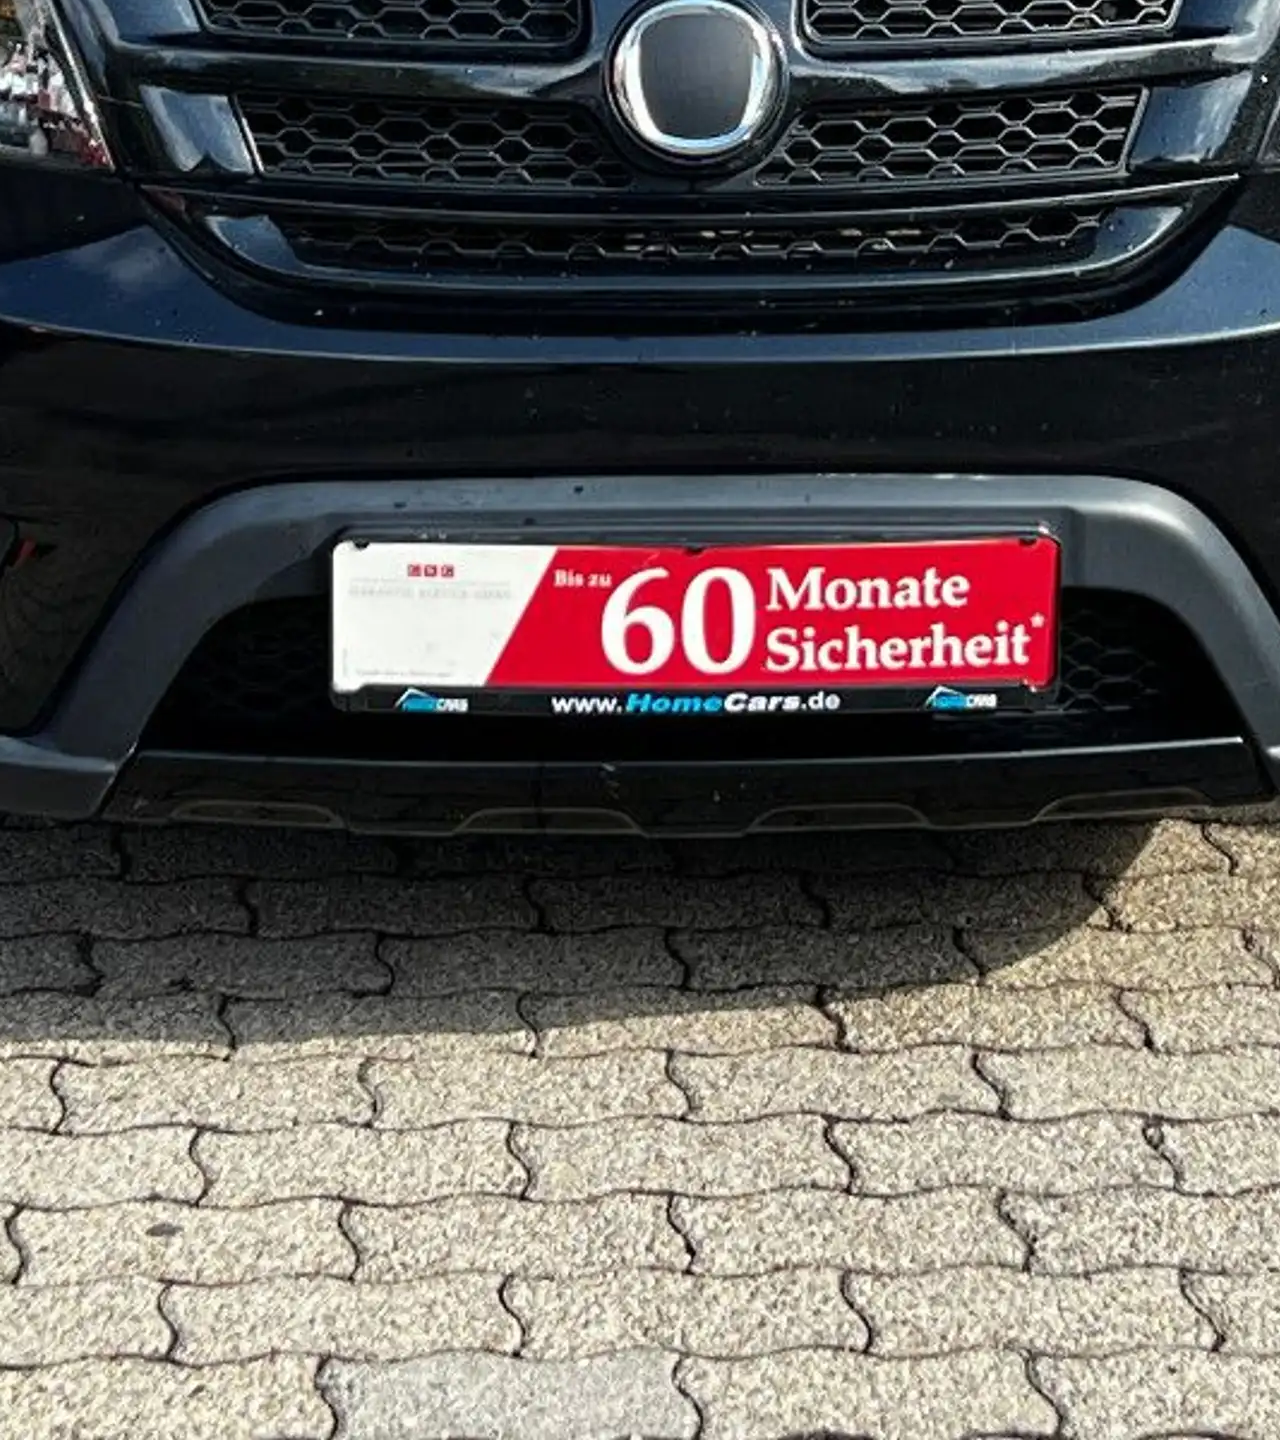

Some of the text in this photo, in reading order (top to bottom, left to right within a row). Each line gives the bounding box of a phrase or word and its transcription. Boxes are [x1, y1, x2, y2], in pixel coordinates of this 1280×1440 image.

[553, 567, 970, 675] Bis zu 60 Monate
[551, 692, 841, 713] www.HomeCars.de
